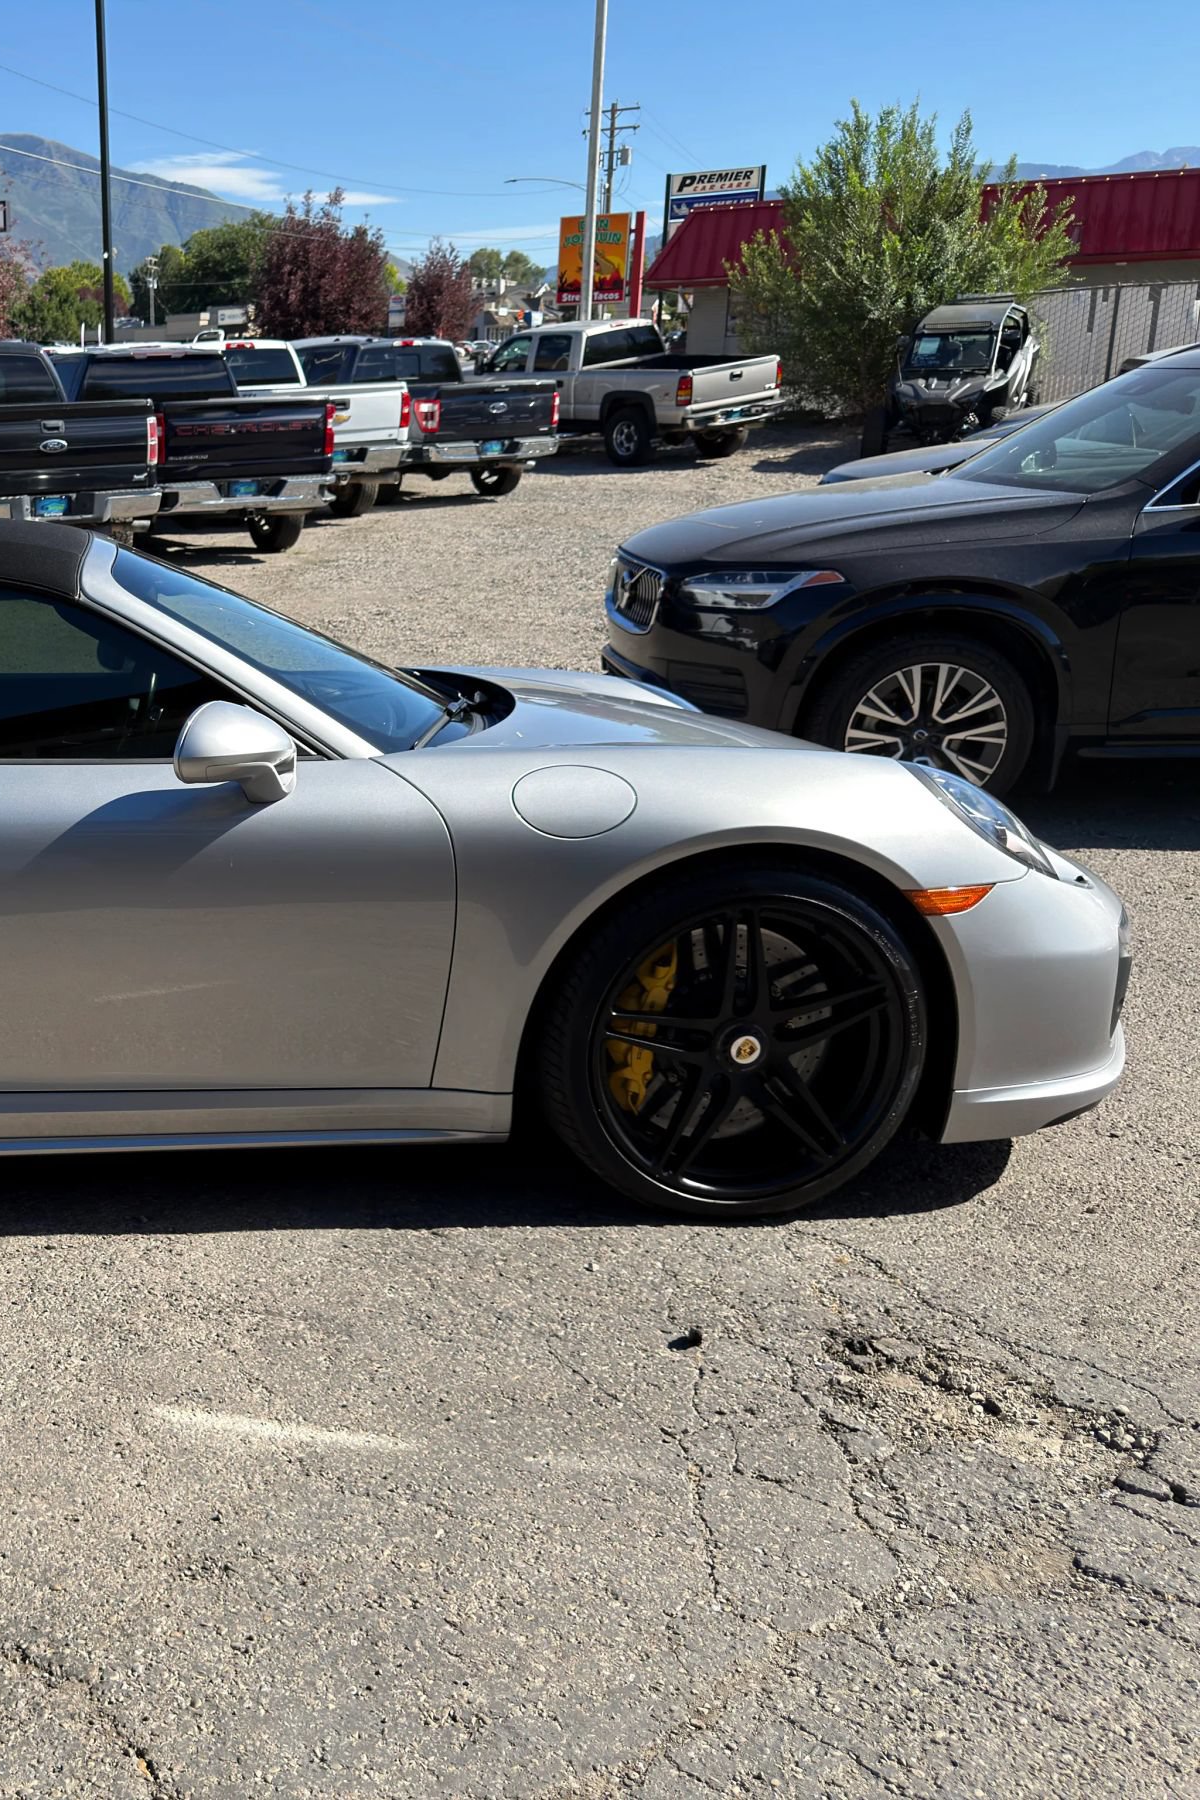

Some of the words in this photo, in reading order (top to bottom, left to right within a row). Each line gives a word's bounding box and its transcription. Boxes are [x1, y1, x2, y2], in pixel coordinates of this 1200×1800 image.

[677, 170, 754, 193] PREMIER
[719, 181, 751, 190] CARE
[563, 231, 622, 247] JOUIN
[593, 291, 620, 300] Tacos
